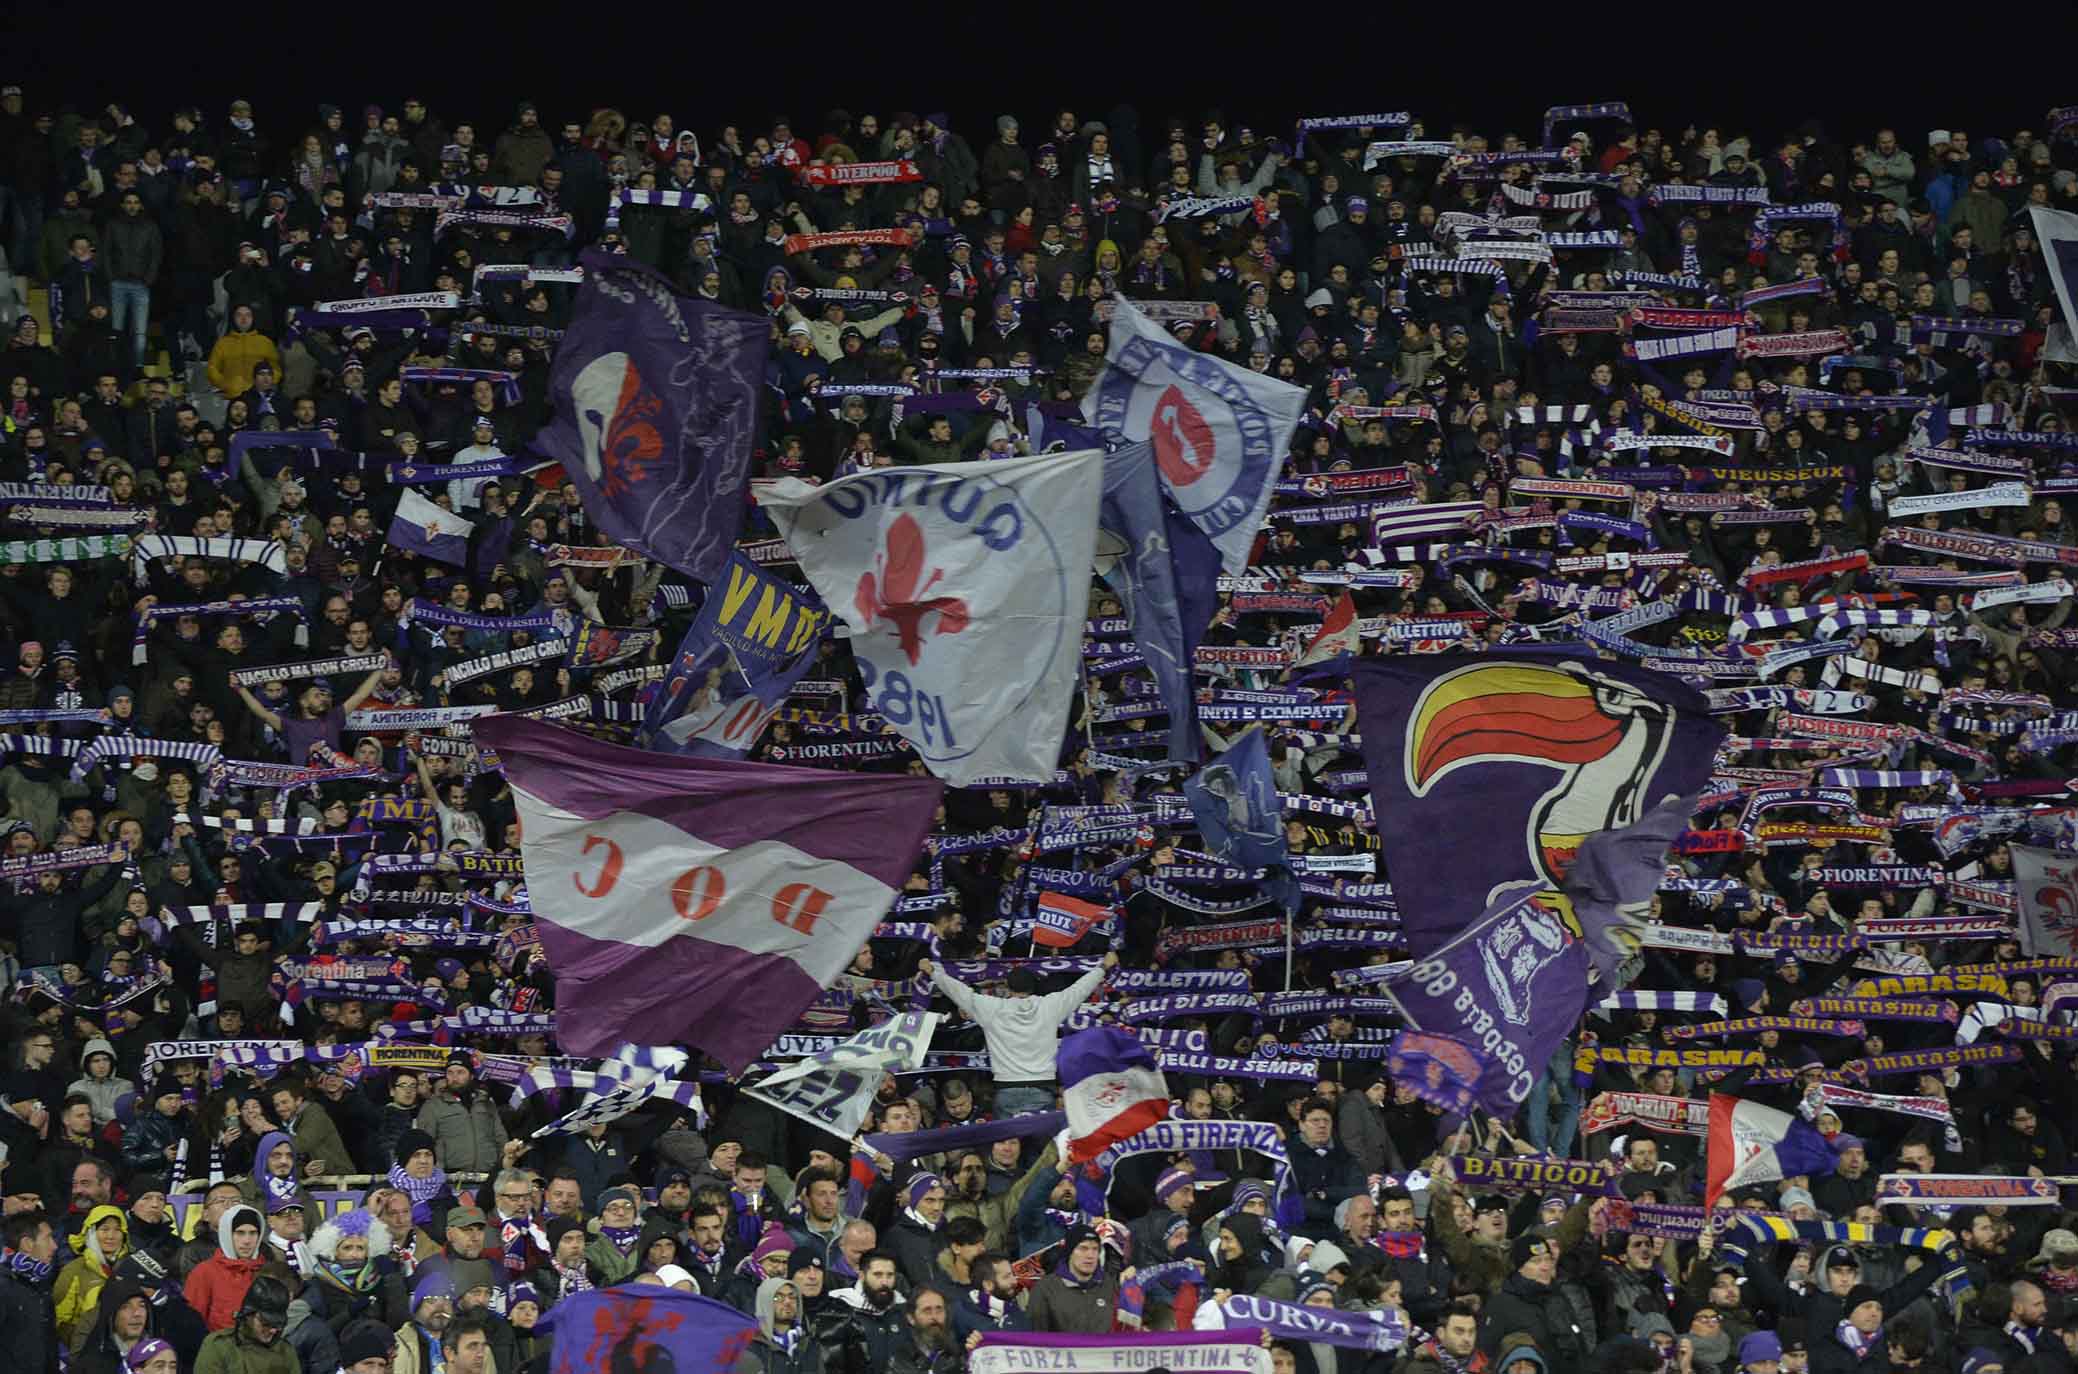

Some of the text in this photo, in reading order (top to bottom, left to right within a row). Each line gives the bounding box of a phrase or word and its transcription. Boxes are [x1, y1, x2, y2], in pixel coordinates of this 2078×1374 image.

[831, 165, 902, 179] LIVERPOOL
[815, 289, 888, 301] FIORENTINA
[961, 369, 1030, 378] FIORENTINA
[847, 386, 914, 397] FIORENTINA
[433, 464, 503, 477] FIORENTINA
[1712, 467, 1844, 482] VIEUSSEUX
[414, 608, 551, 628] STELLA DELLA VERSILIA
[491, 653, 509, 668] MA
[510, 648, 538, 664] NON
[237, 656, 386, 685] VACILLO MA NON CROLLO
[1823, 690, 1866, 711] 26
[1243, 706, 1256, 719] E
[1261, 704, 1346, 719] COMPATT
[1787, 715, 1889, 738] FIORENTINA
[422, 736, 472, 757] CONTR
[789, 742, 896, 759] FIORENTINA
[1160, 867, 1216, 880] UELLI
[1823, 868, 1933, 884] FIORENTINA
[1345, 884, 1392, 897] QUEL
[1867, 920, 1937, 933] FORZA
[1373, 930, 1396, 942] DI
[1112, 970, 1246, 988] COLLETTIVO
[1174, 997, 1198, 1010] DI
[1203, 993, 1258, 1008] SEMP
[1819, 999, 1937, 1018] marasma
[1702, 1015, 1835, 1036] marasma
[776, 1036, 825, 1053] UVE
[376, 1048, 443, 1061] FIORENTINA
[1873, 1045, 2004, 1070] marasma
[1215, 1058, 1237, 1071] DI
[1242, 1058, 1317, 1078] SEMPR
[1464, 1157, 1606, 1187] BATIGOL
[1917, 1180, 2025, 1198] FIORENTINA
[1004, 1348, 1232, 1370] FORZA FIORENTINA
